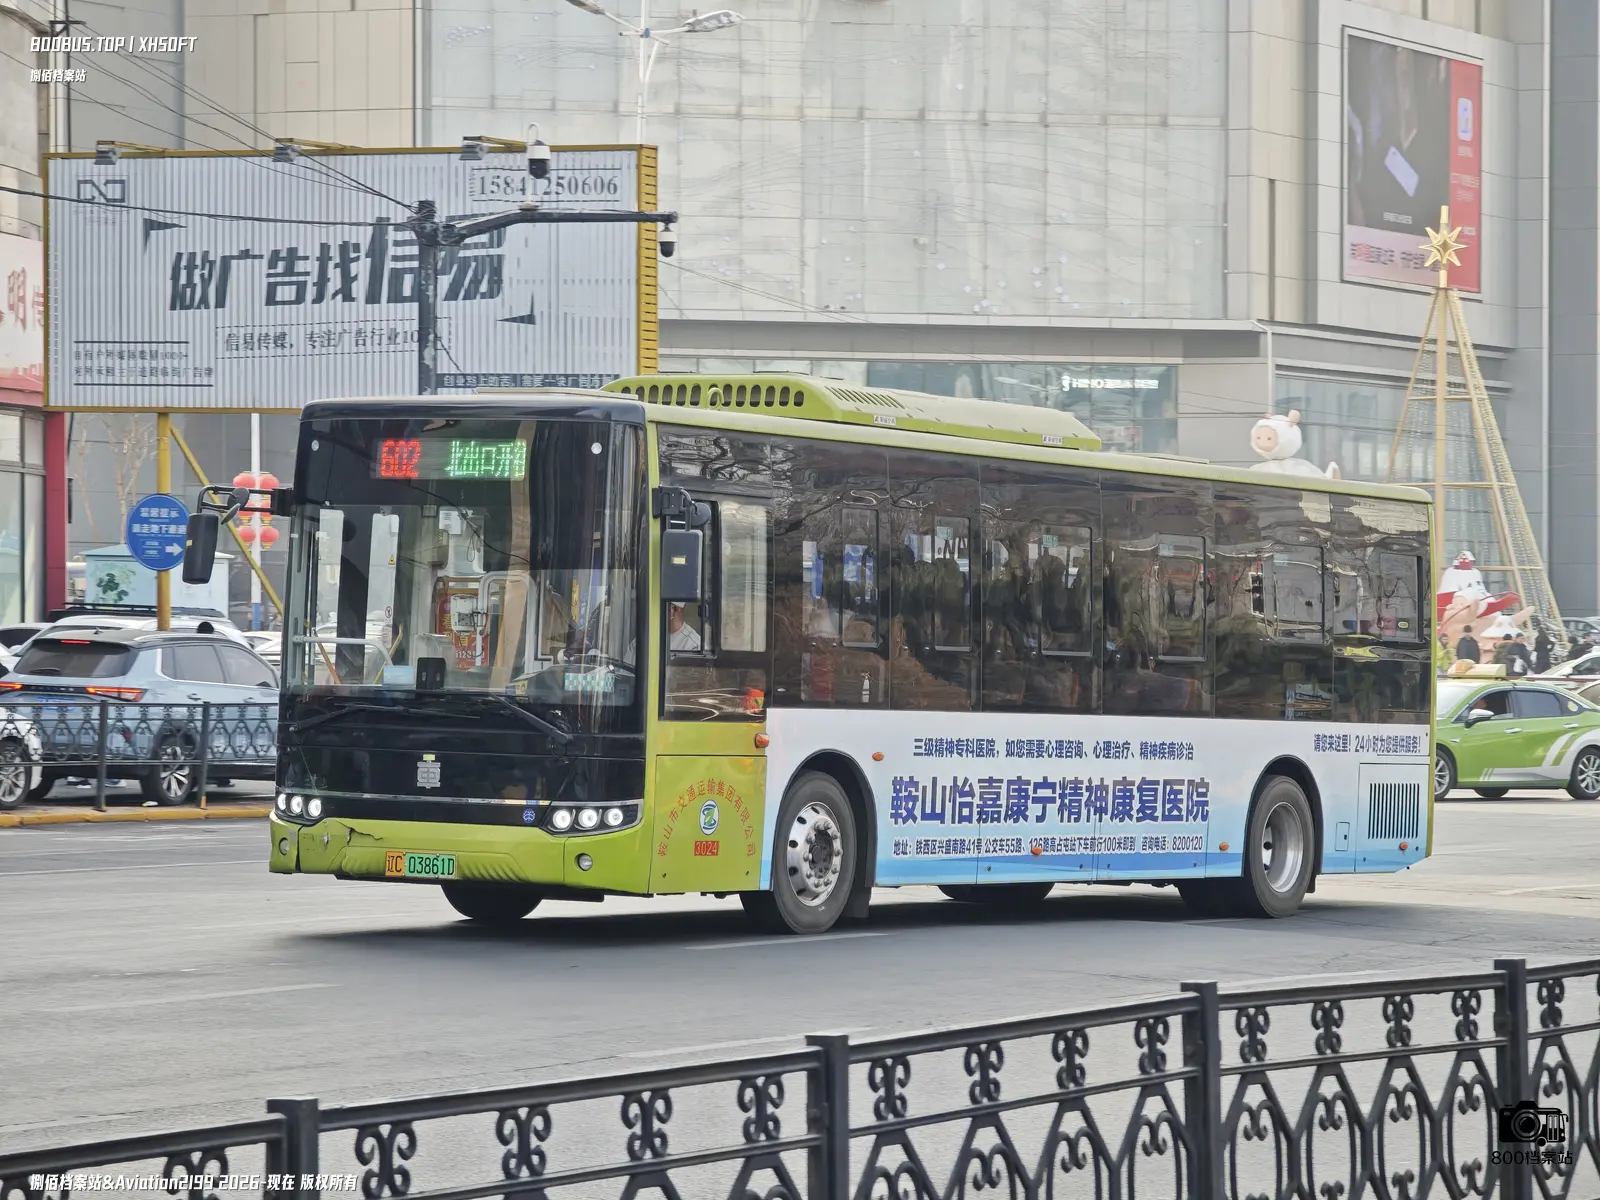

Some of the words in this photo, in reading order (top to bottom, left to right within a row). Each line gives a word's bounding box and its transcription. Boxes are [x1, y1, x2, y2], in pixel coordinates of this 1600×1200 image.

[479, 175, 618, 196] 15841250606
[225, 327, 419, 352] 信易传媒，专注广告行业10
[381, 439, 421, 477] 602
[890, 775, 1210, 825] 鞍山怡嘉康宁精神康复医院
[657, 778, 756, 857] 鞍山市交通运输集团有限公司
[695, 841, 718, 856] 3024
[408, 856, 455, 876] 03861D
